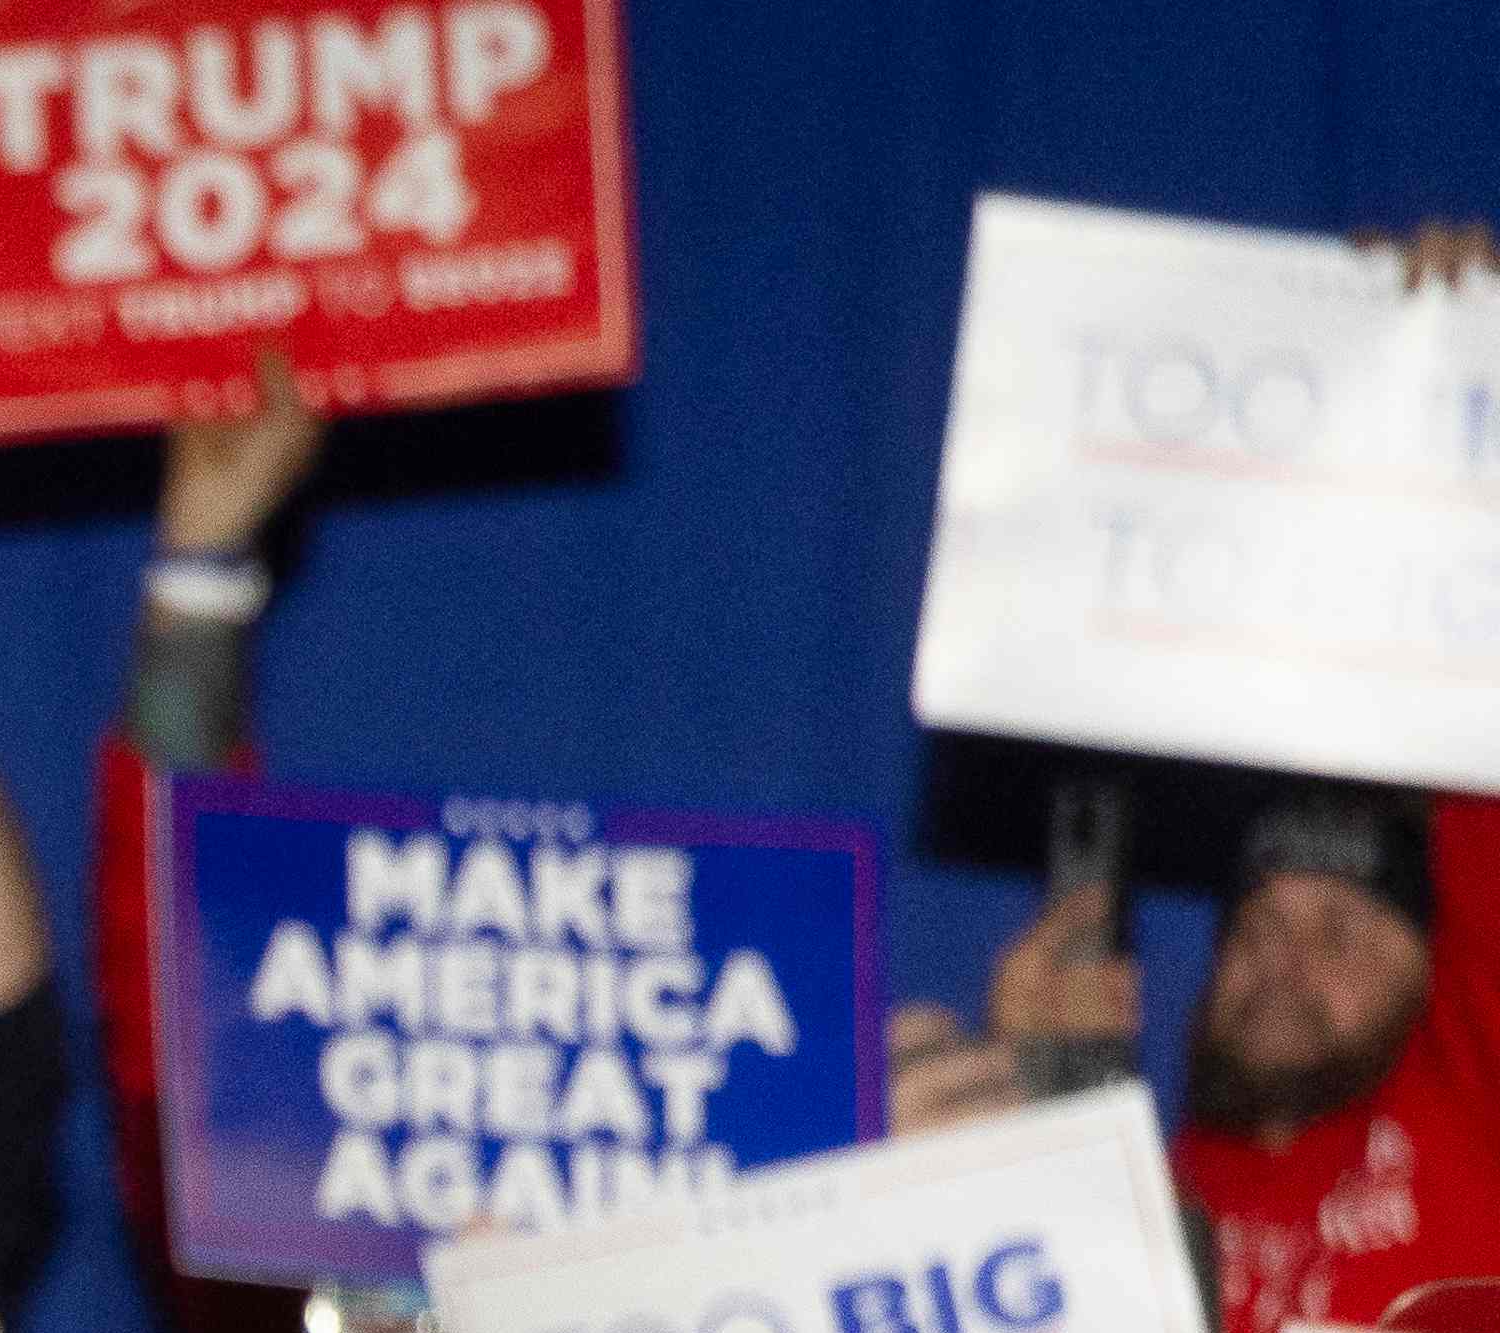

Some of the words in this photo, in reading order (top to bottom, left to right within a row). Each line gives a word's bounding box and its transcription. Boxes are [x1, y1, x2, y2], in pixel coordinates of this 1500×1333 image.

[53, 126, 475, 282] 2024
[346, 826, 694, 953] MAKE
[251, 919, 796, 1057] AMERICA
[319, 1029, 727, 1145] GREAT
